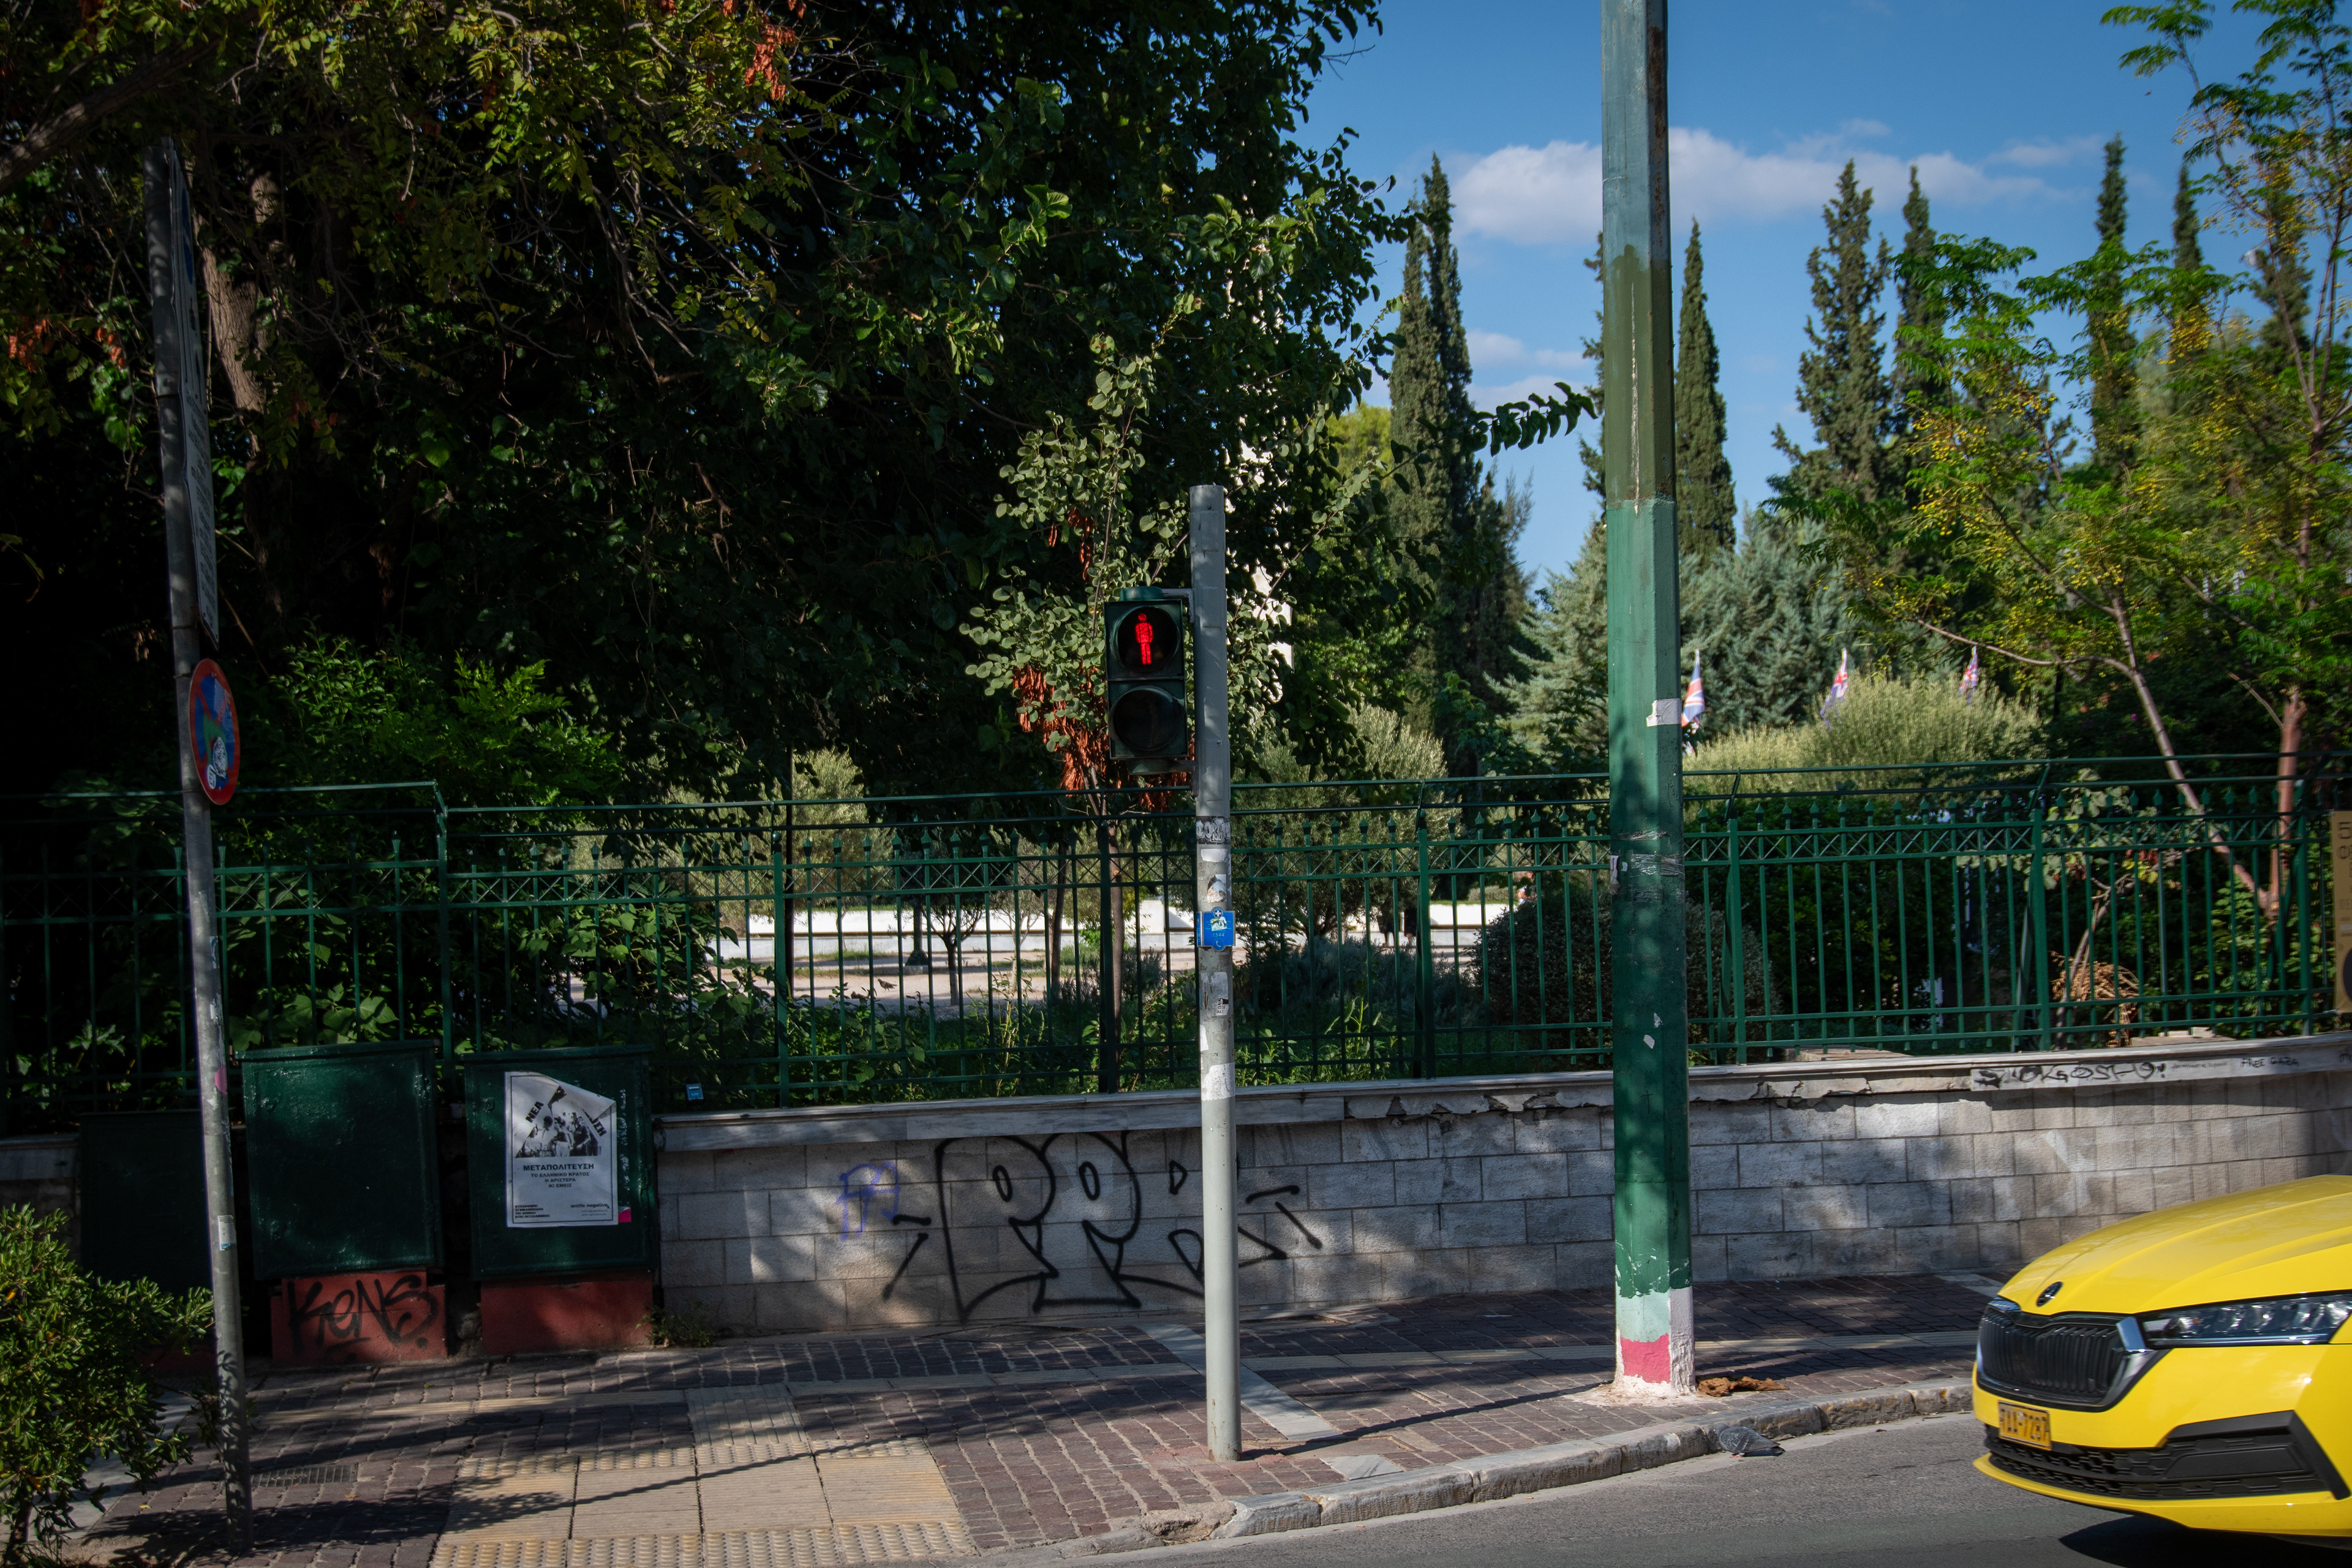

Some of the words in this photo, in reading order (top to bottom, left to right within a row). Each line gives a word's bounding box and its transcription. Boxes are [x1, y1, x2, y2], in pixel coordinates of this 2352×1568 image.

[2241, 1058, 2266, 1068] FREE
[2269, 1057, 2299, 1066] GAZA
[526, 1101, 545, 1123] ΝΕΑ
